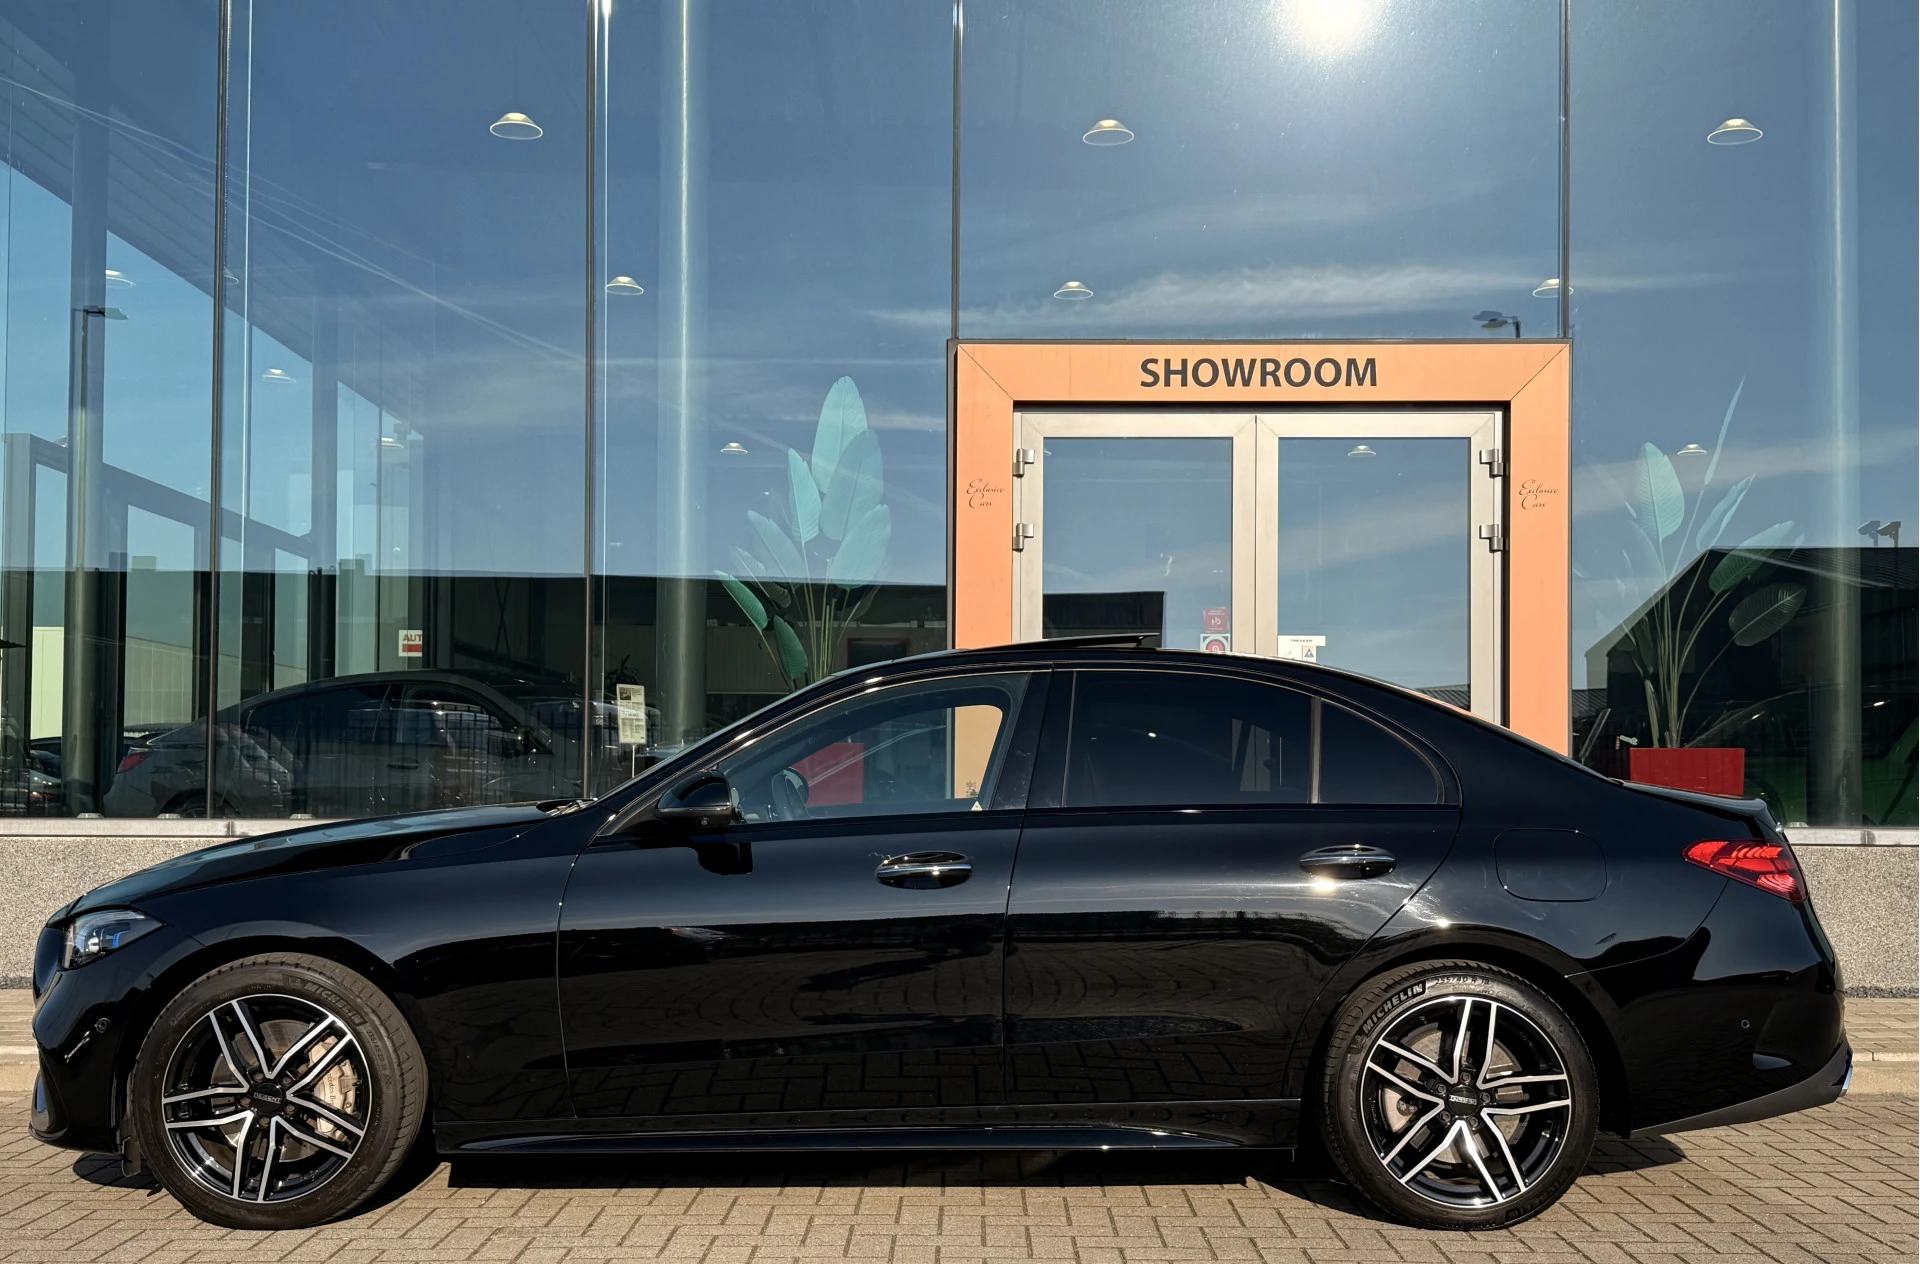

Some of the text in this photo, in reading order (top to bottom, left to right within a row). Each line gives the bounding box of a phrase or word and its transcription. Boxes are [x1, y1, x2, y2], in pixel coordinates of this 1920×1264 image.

[1140, 357, 1377, 388] SHOWROOM
[966, 478, 1005, 495] Exclusive
[1518, 478, 1558, 495] Exclusive
[968, 492, 992, 509] Cars
[1521, 493, 1546, 510] Cars
[303, 982, 362, 1024] MICHELIN
[1361, 983, 1423, 1034] MICHELIN
